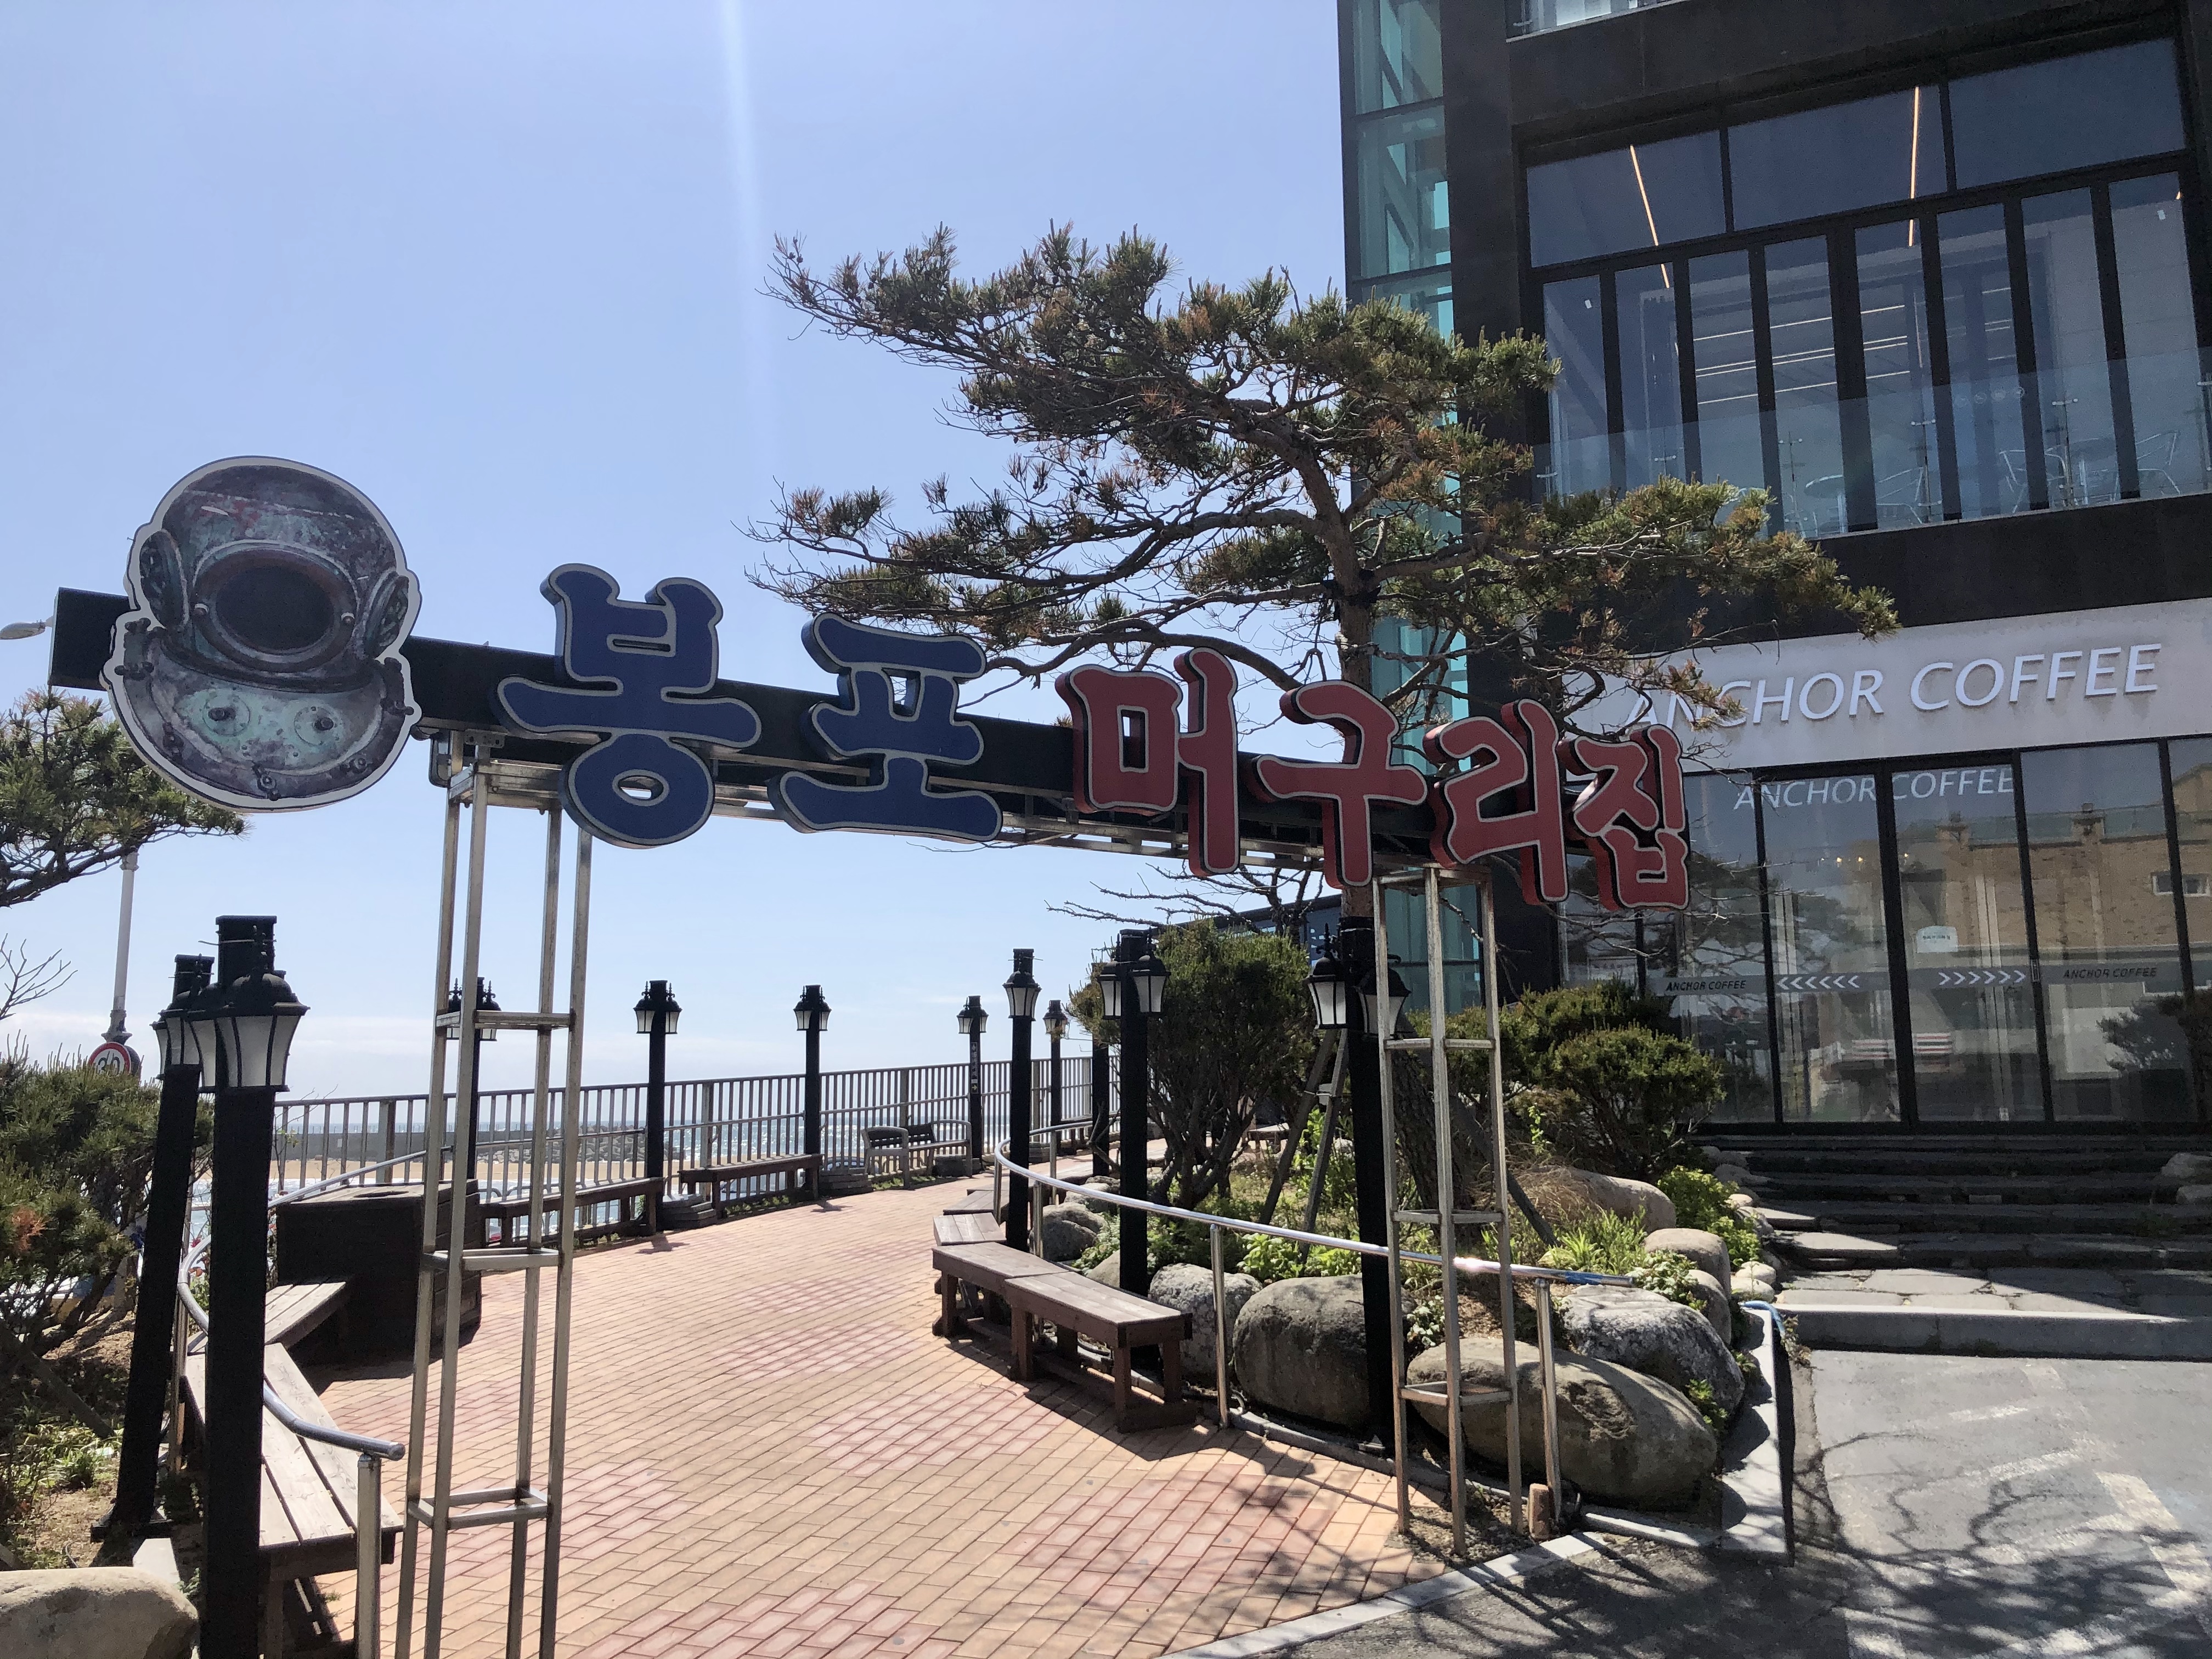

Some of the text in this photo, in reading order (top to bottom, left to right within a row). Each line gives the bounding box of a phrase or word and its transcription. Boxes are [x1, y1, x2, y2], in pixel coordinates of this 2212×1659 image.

[1627, 643, 2162, 729] ANCHOR COFFEE
[490, 563, 1690, 911] 봉포 머구리집
[1733, 768, 2013, 810] ANCHOR COFFEE
[1666, 980, 1746, 992] ANCHOR COFFEE
[2063, 967, 2158, 979] ANCHOR COFFEE
